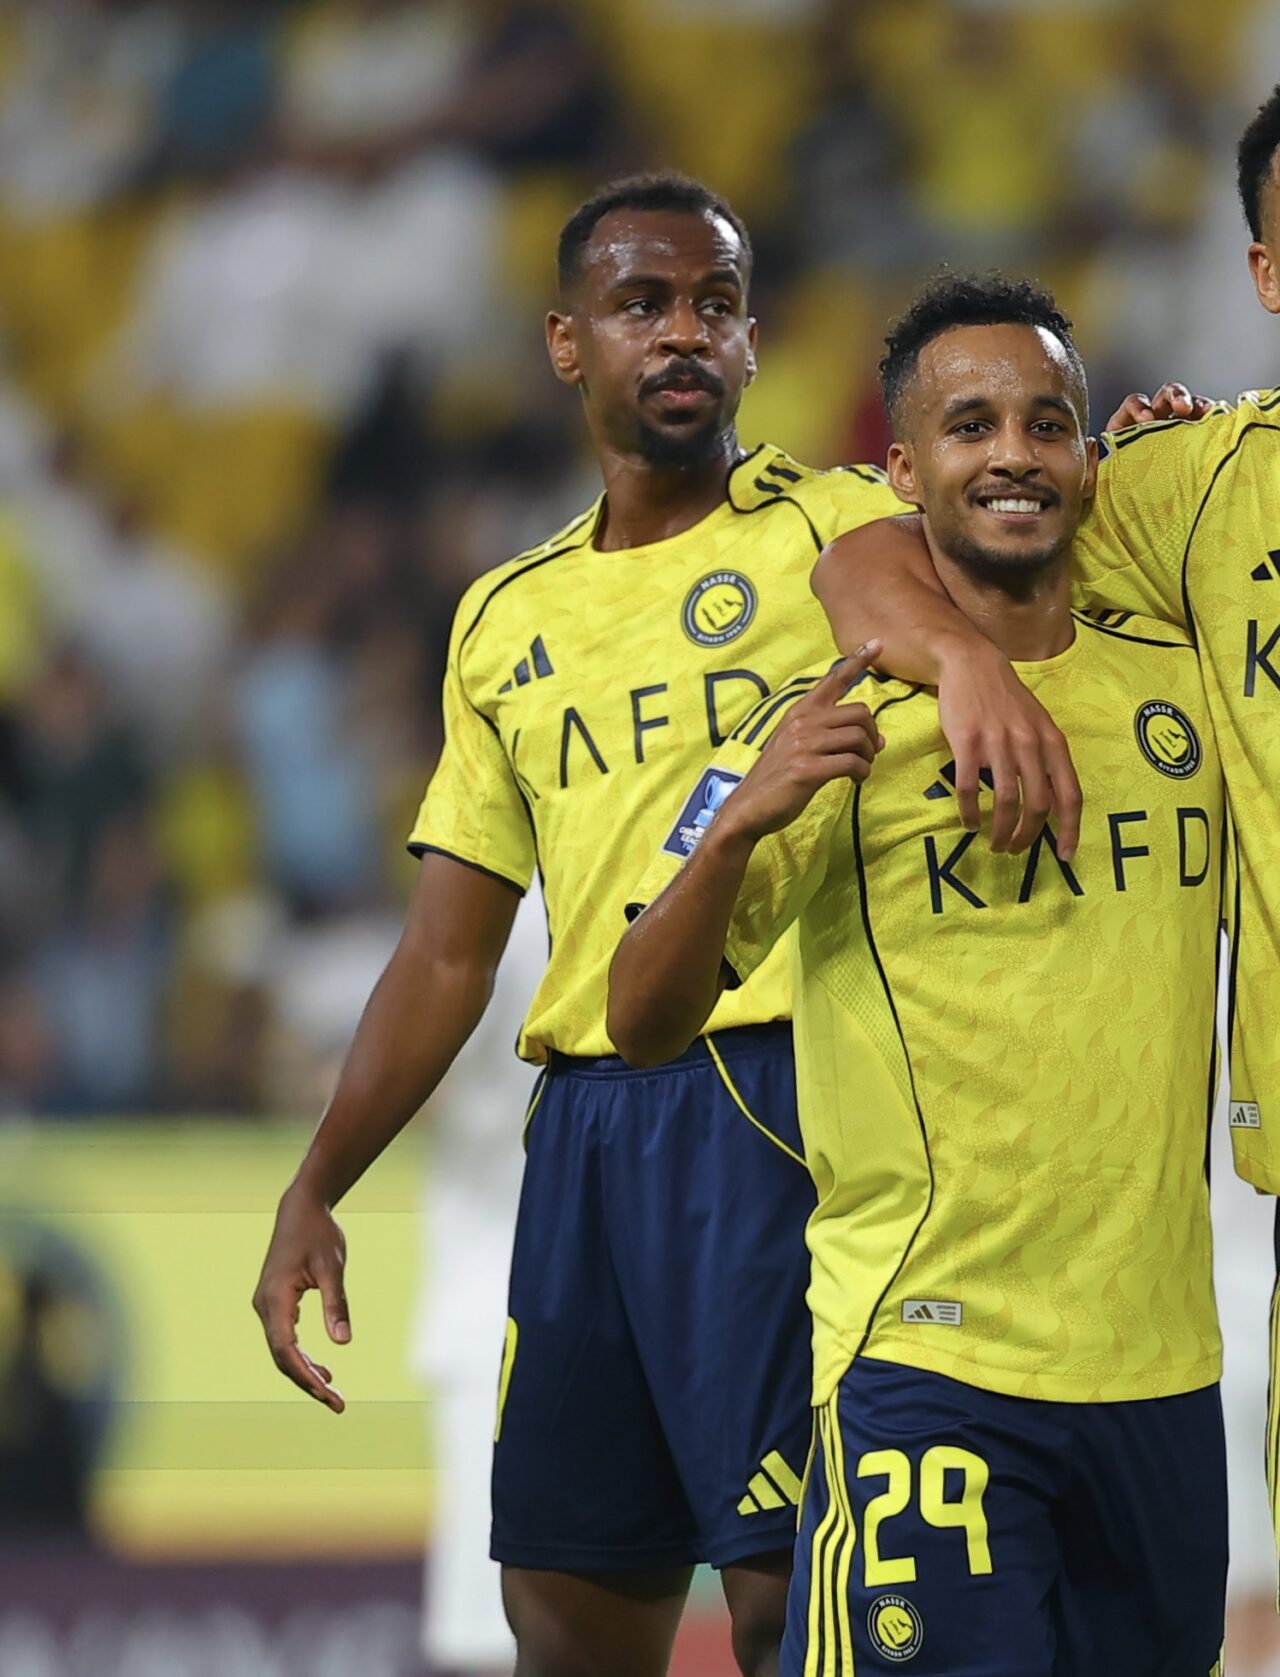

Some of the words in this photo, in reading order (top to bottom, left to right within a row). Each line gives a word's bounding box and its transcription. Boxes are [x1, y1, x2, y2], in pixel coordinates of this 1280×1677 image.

[700, 573, 737, 590] NASSR
[1143, 704, 1174, 717] NASSR
[924, 807, 1210, 914] KAFD
[857, 1445, 993, 1588] 29
